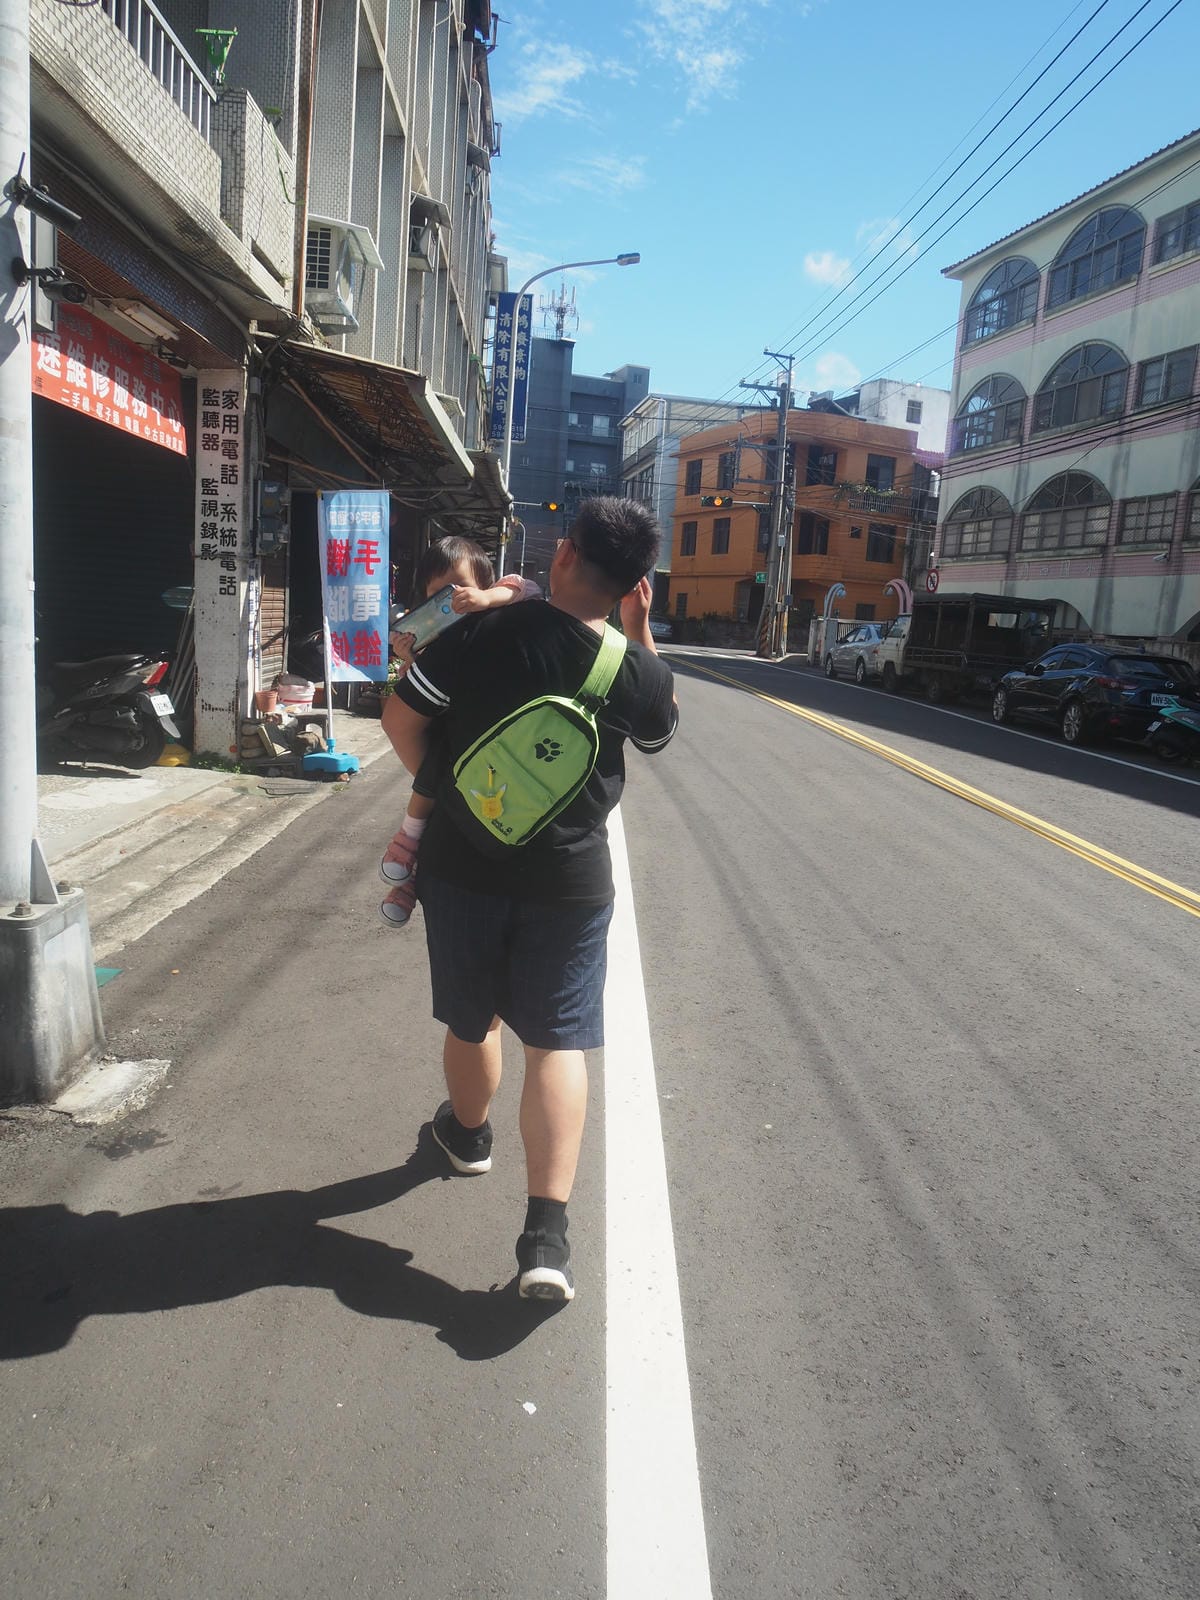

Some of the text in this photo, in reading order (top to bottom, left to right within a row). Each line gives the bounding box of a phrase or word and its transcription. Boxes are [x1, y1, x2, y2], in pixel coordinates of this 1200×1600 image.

[495, 312, 513, 414] 清除有限公司
